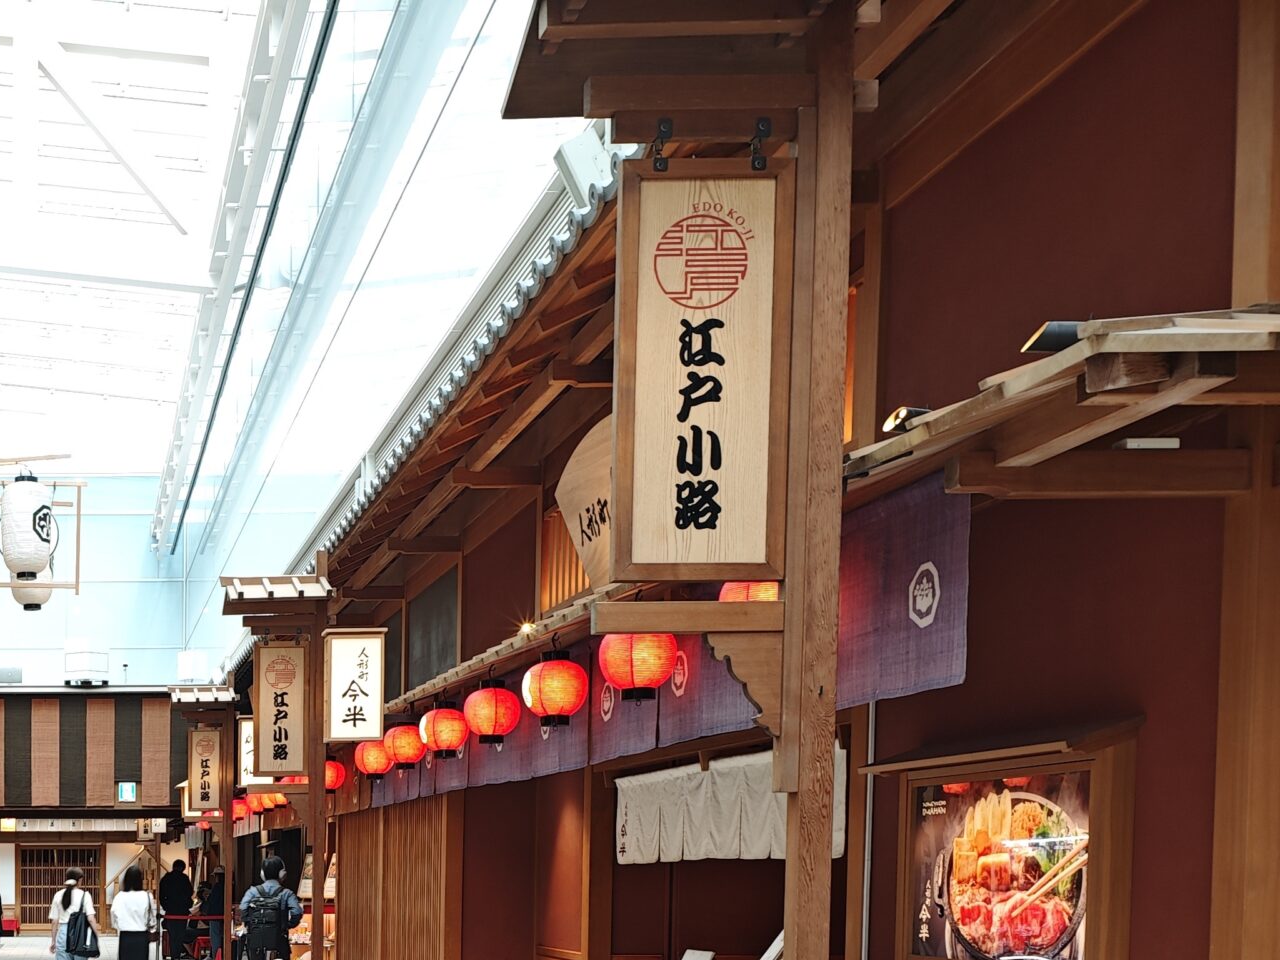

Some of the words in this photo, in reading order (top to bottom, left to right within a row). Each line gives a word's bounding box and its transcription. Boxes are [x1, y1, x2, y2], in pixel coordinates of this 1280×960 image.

[692, 201, 724, 214] EDO
[726, 208, 756, 242] KO-JI
[674, 317, 726, 531] 江戸小路
[272, 691, 290, 761] 江戸小路
[341, 679, 370, 729] 今半
[200, 758, 212, 802] 江戸小路
[918, 904, 932, 943] 今半
